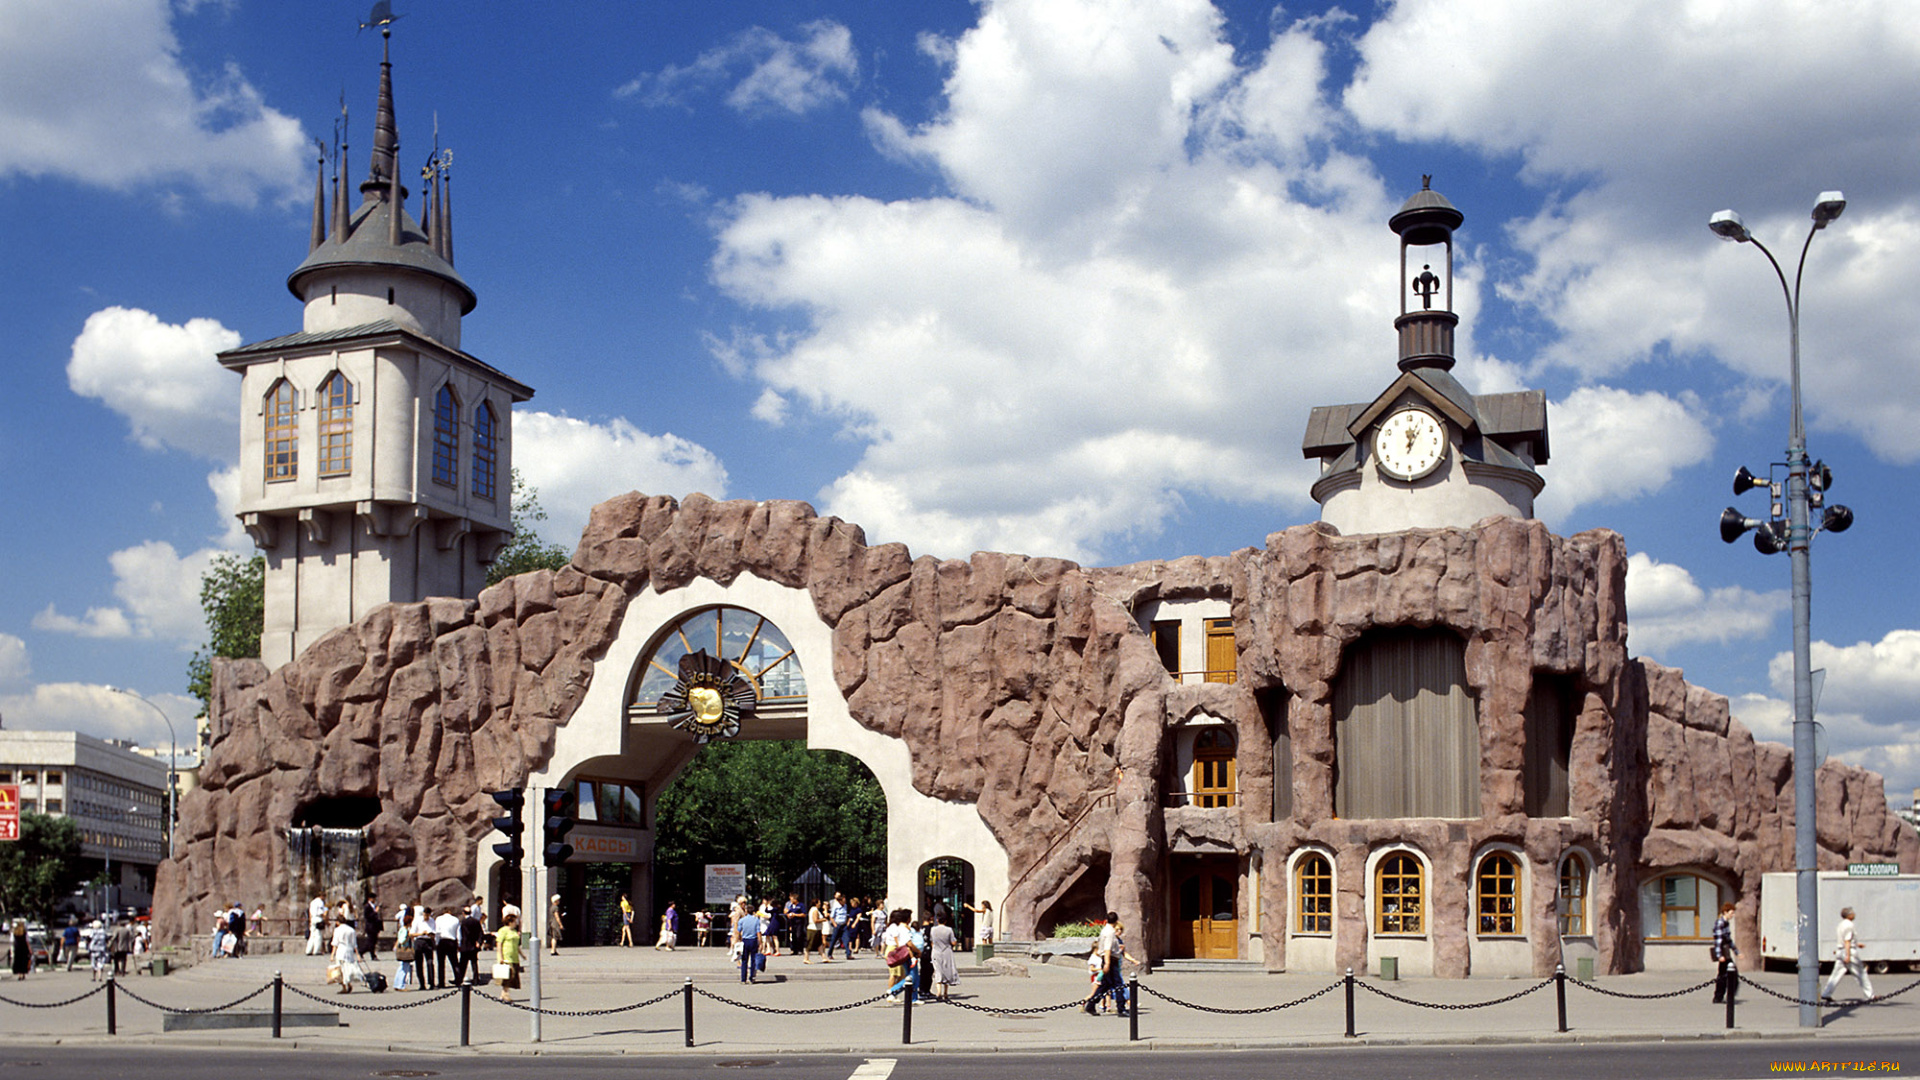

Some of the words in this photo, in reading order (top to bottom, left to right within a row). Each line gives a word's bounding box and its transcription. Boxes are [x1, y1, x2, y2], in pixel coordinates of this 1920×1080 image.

[575, 836, 632, 853] КАССЫ
[1850, 865, 1869, 875] КАССЫ
[1870, 865, 1898, 875] ЗООПАРКА
